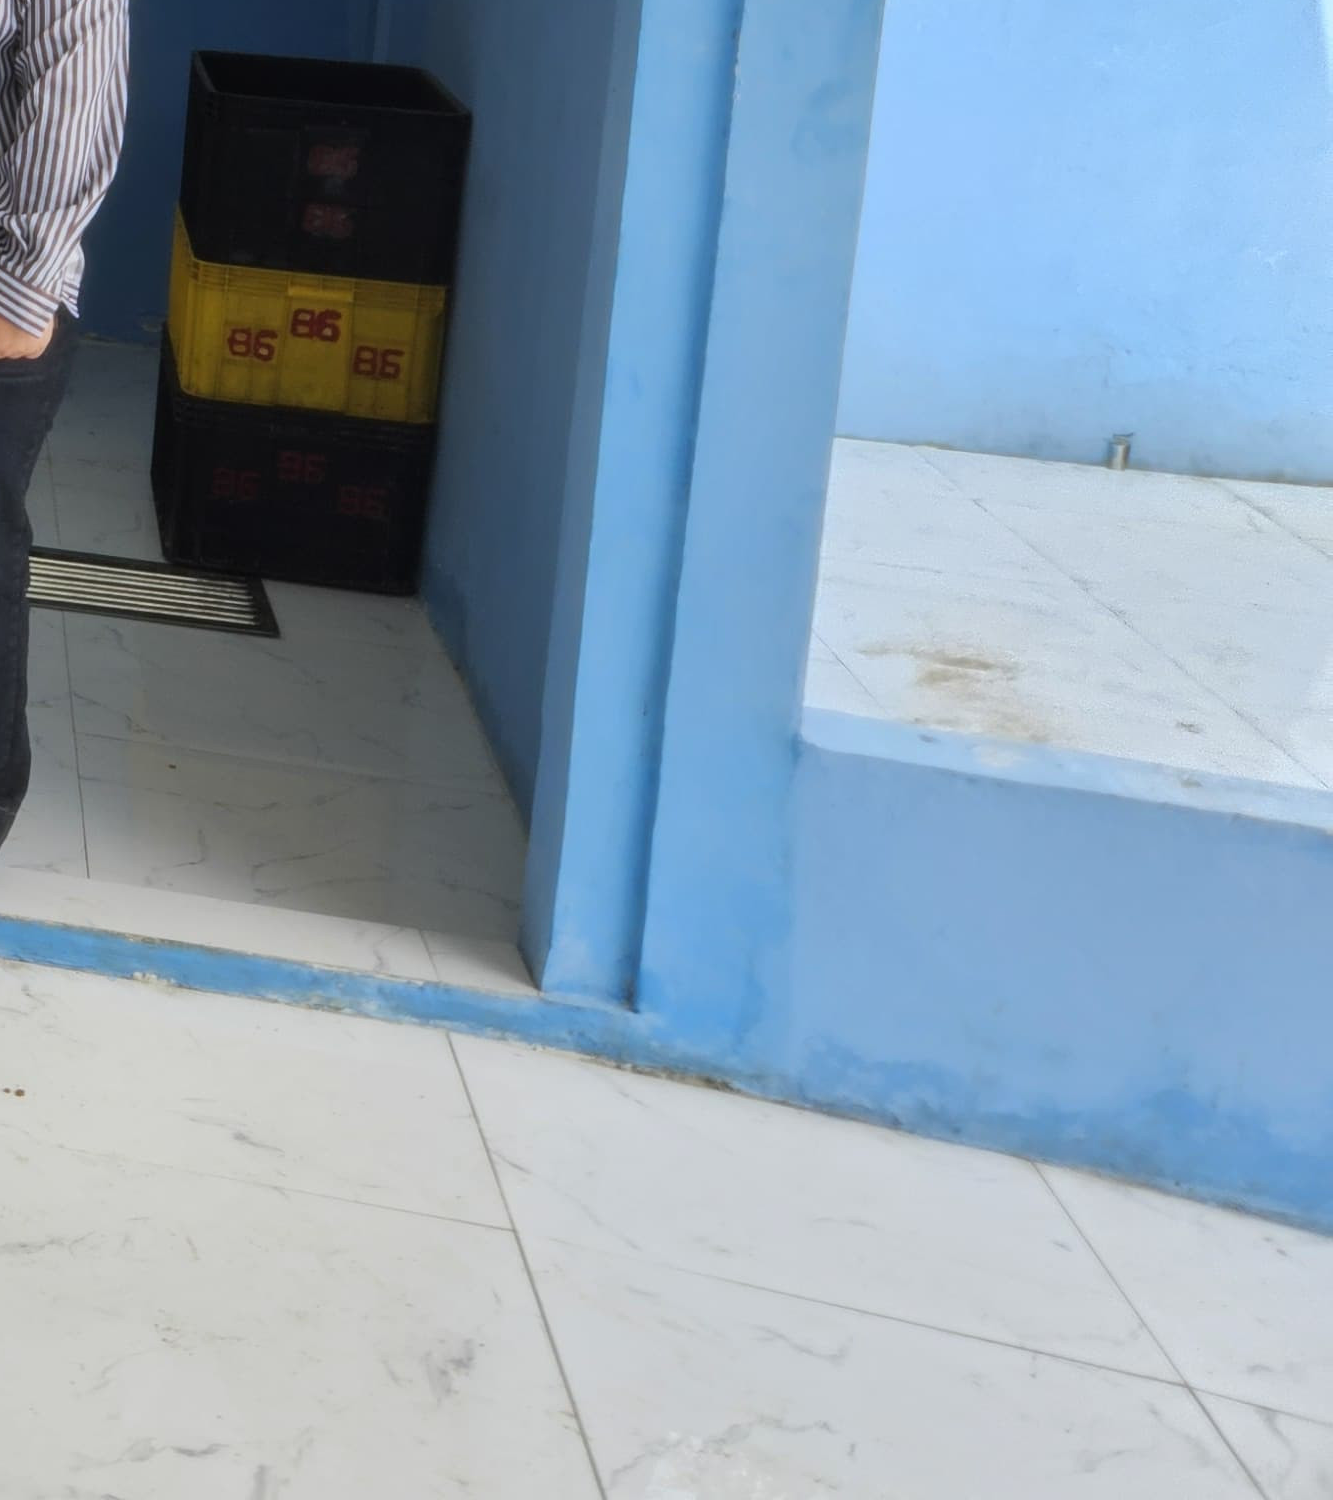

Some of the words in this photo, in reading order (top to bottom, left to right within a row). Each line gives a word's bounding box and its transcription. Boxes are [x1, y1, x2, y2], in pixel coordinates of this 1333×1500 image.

[291, 308, 342, 343] 86
[227, 327, 278, 362] 86
[353, 345, 405, 379] 86
